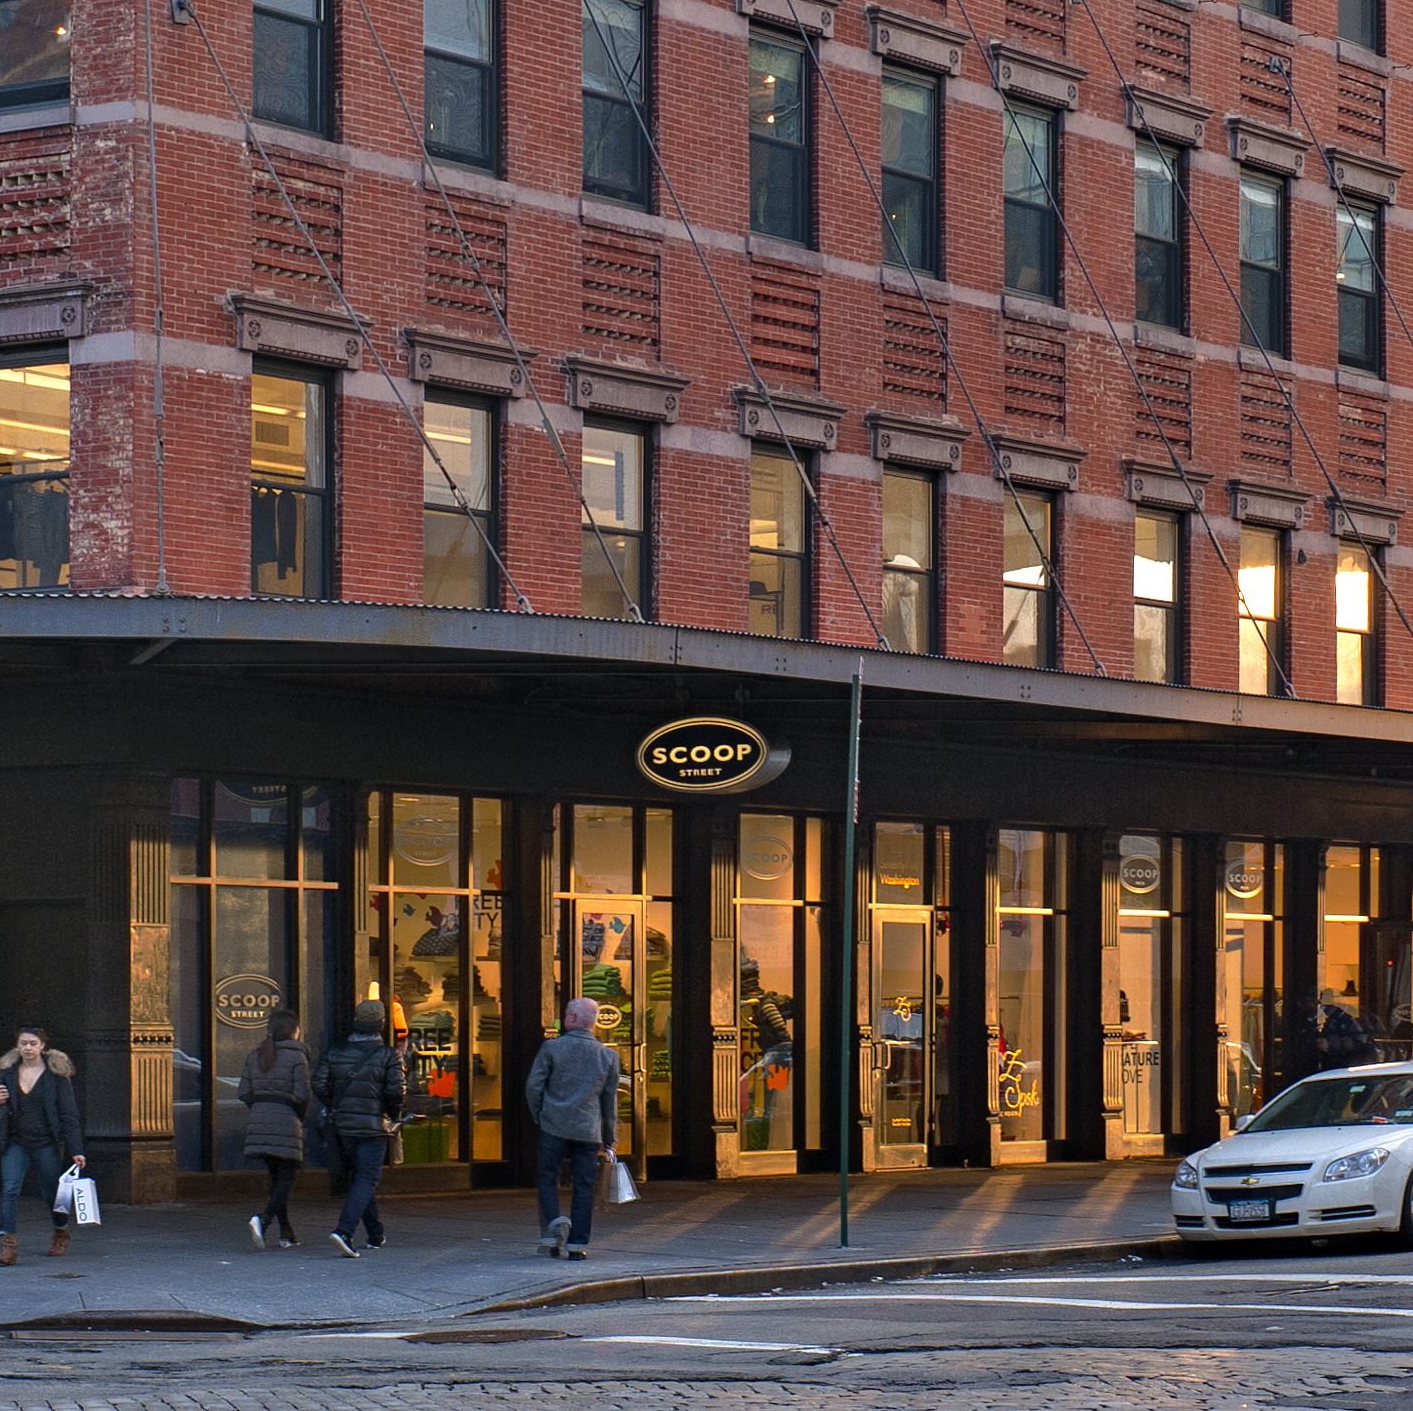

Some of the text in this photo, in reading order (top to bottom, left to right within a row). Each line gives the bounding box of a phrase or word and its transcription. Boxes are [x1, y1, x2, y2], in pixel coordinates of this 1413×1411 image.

[652, 744, 752, 764] SCOOP
[679, 768, 722, 777] STREET
[401, 836, 452, 846] SCOOP
[1123, 868, 1158, 878] SCOOP
[1228, 874, 1260, 883] SCOOP
[219, 994, 280, 1007] SCOOP
[231, 1010, 264, 1018] STREET
[76, 1188, 87, 1221] ALDO
